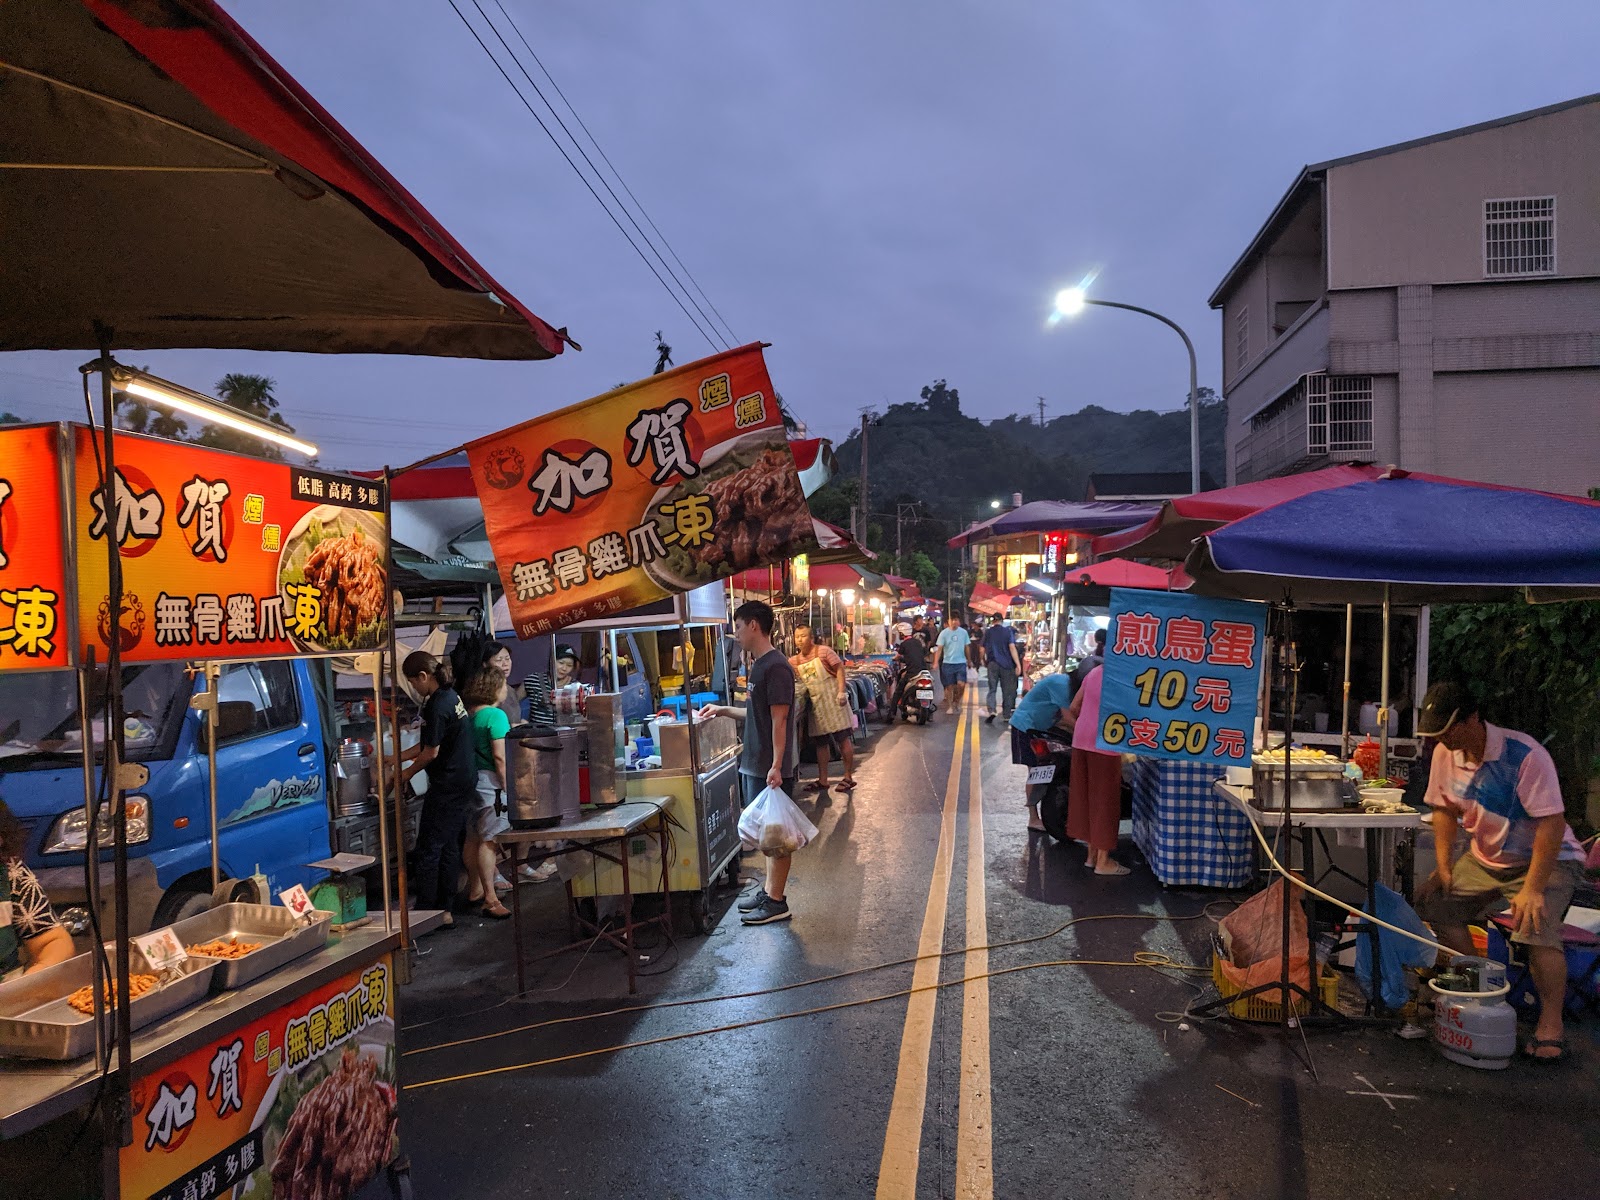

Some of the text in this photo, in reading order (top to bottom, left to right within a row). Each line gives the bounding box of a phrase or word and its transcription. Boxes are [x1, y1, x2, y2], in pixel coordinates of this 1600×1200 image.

[700, 374, 766, 428] 煙燻
[530, 400, 699, 515] 加賀
[91, 467, 229, 562] 加賀
[298, 476, 379, 506] 低脂 高鈣 多膠
[243, 494, 281, 552] 煙燻
[512, 494, 716, 601] 無骨雞爪凍
[155, 583, 322, 645] 無骨雞爪凍
[522, 618, 552, 636] 低脂
[1113, 611, 1256, 668] 煎鳥蛋
[287, 965, 387, 1069] 無骨雞爪凍
[146, 1037, 244, 1151] 加賀
